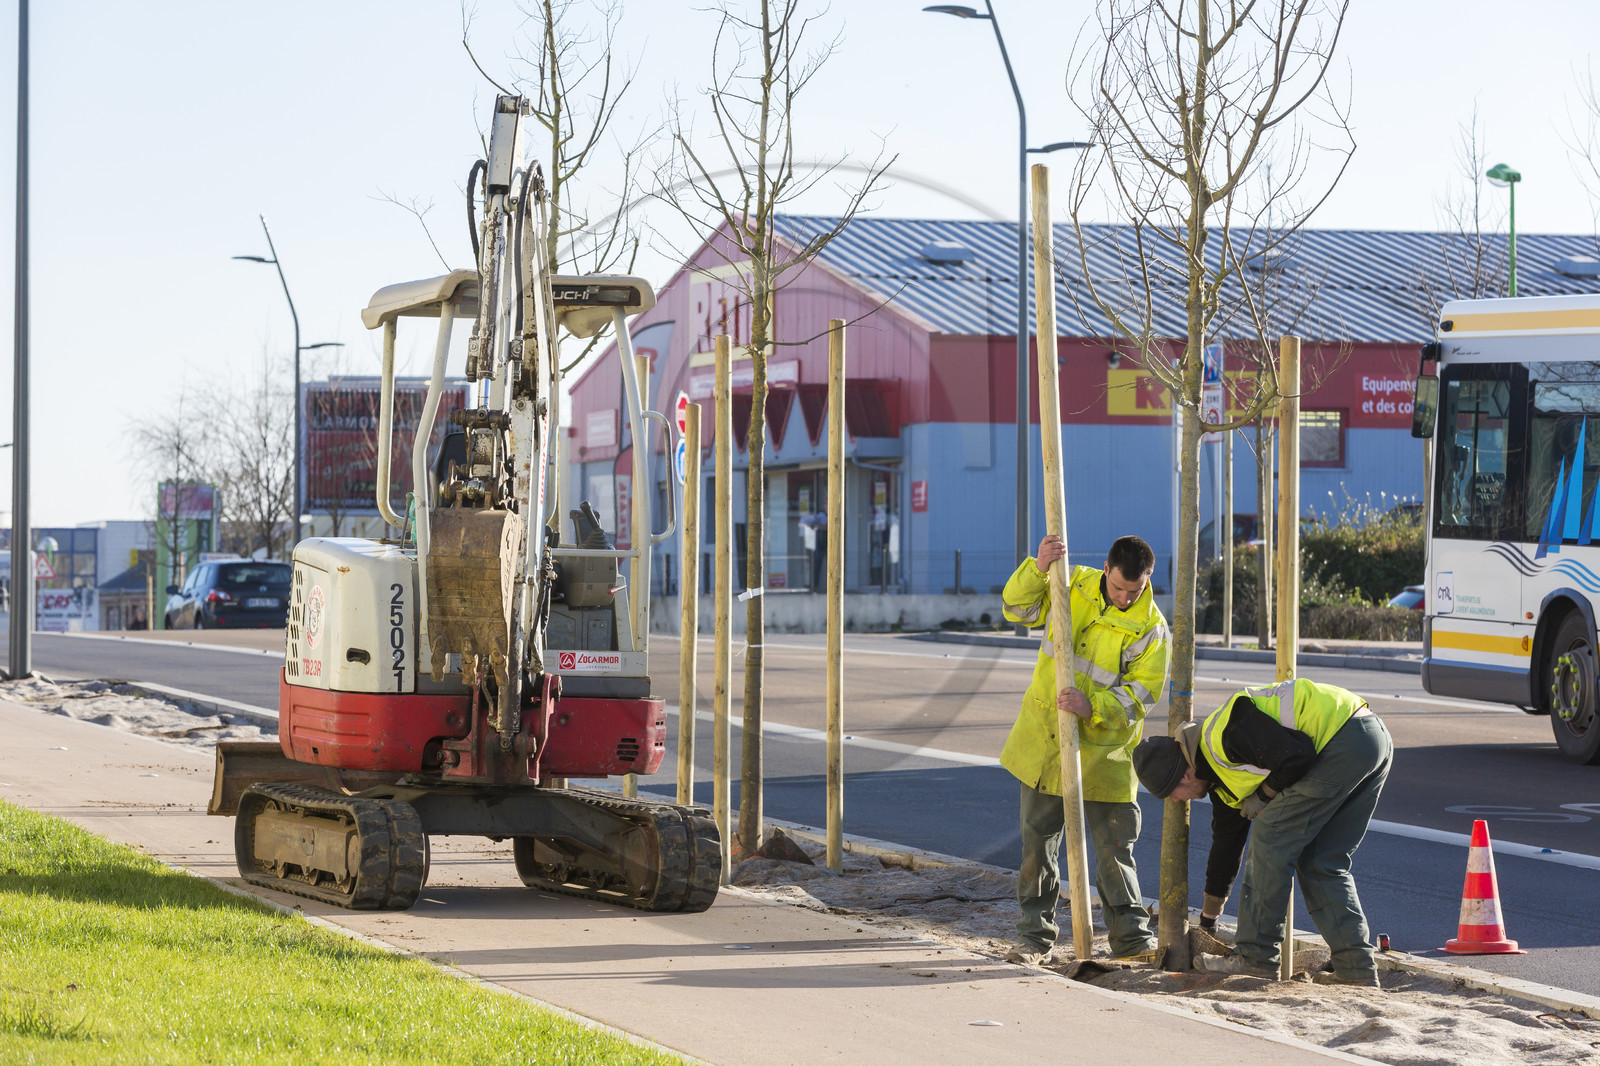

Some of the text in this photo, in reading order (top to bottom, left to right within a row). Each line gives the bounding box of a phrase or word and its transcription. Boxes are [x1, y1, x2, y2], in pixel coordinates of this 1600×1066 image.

[552, 291, 590, 300] UCHI
[1362, 376, 1416, 396] Equipeme
[1362, 399, 1374, 414] et
[1376, 398, 1396, 414] des
[390, 583, 405, 692] 25021
